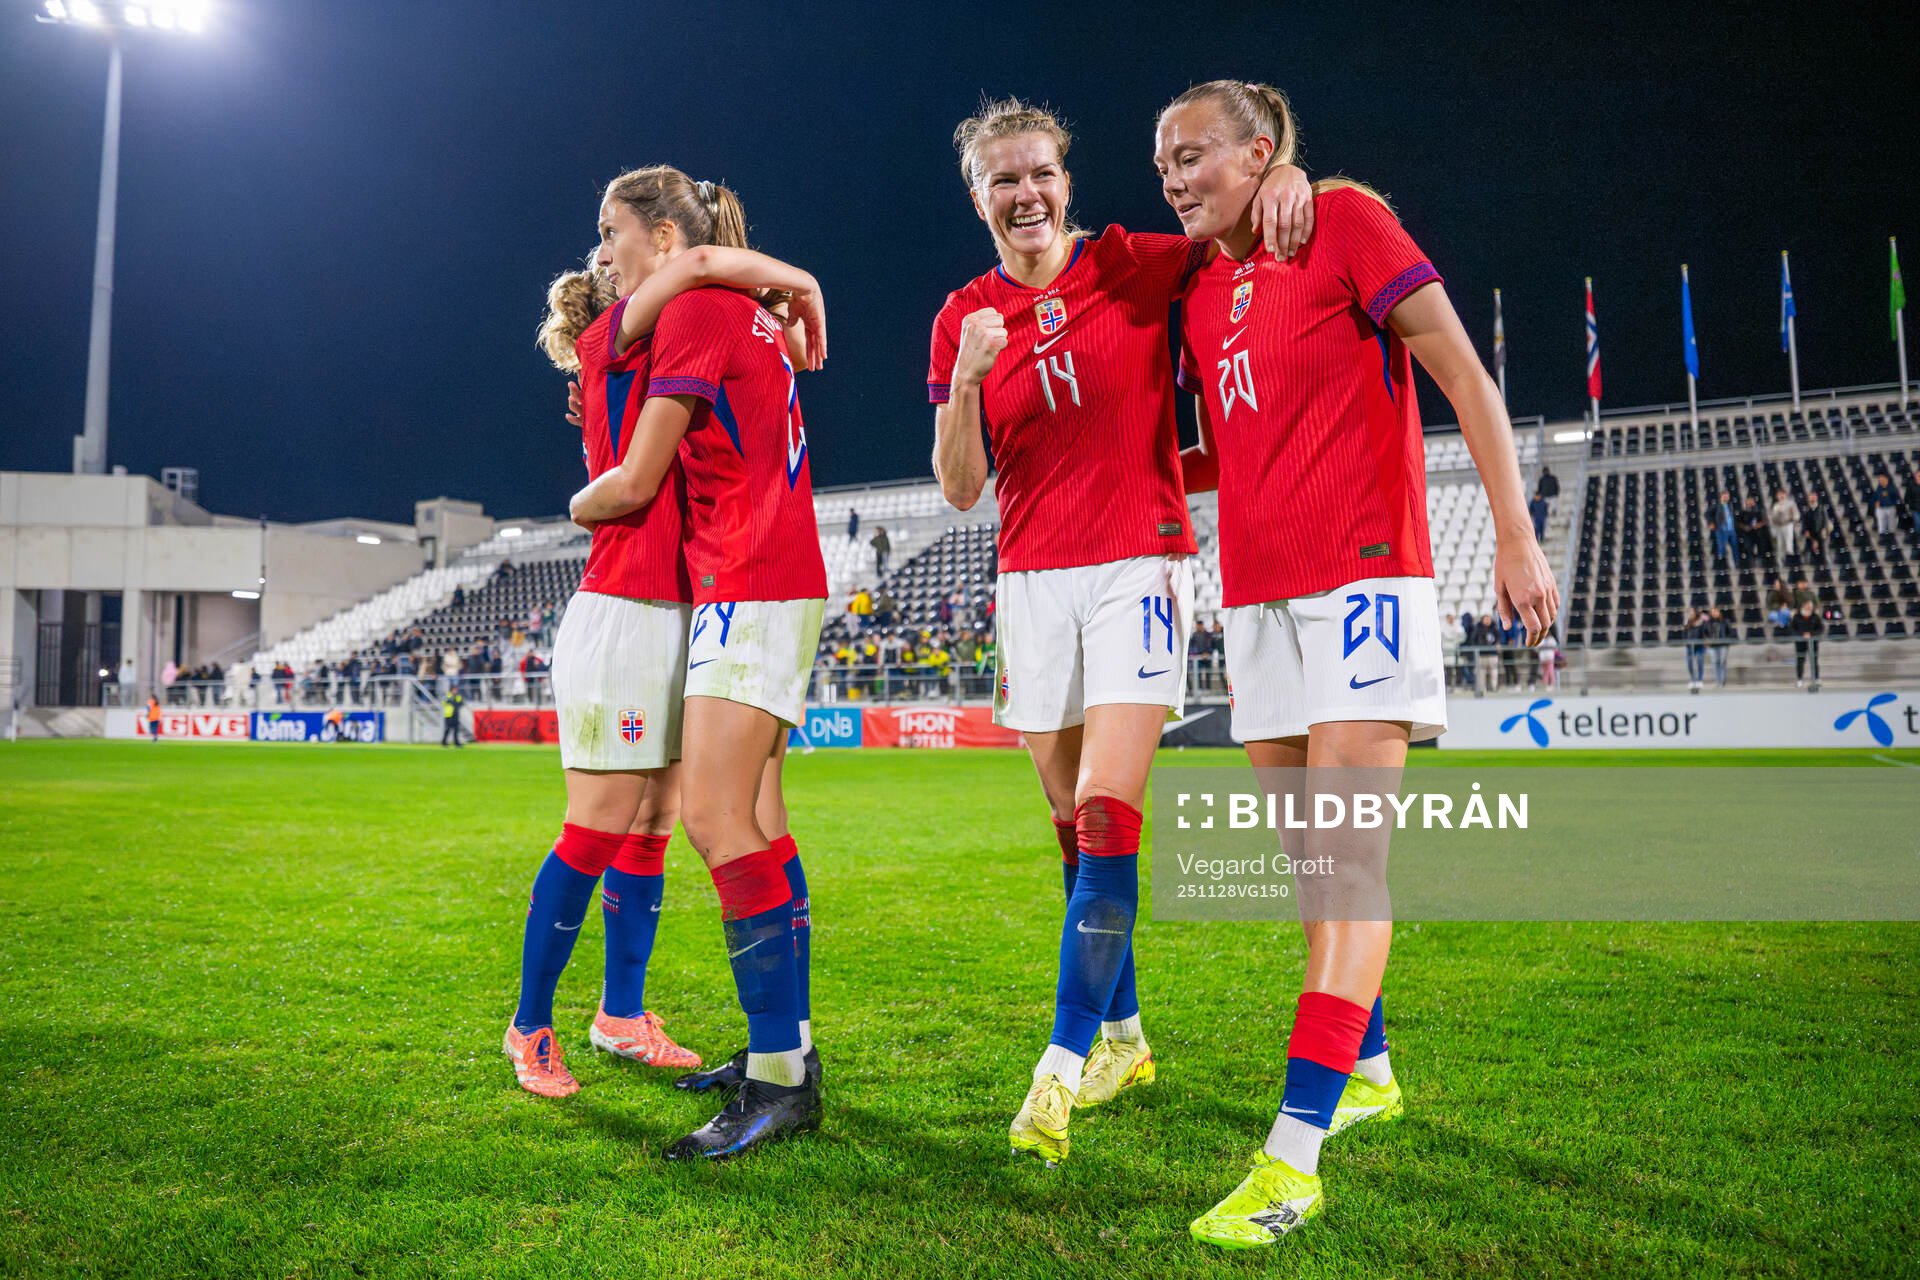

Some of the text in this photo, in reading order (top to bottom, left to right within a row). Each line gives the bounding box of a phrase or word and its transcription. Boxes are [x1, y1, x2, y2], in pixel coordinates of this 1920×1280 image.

[1034, 350, 1081, 413] 14
[1217, 348, 1258, 423] 20
[1139, 594, 1174, 655] 14
[1342, 592, 1400, 664] 20
[194, 714, 246, 735] VG
[811, 711, 853, 743] DNB
[893, 708, 962, 732] THON
[1557, 706, 1698, 737] telenor
